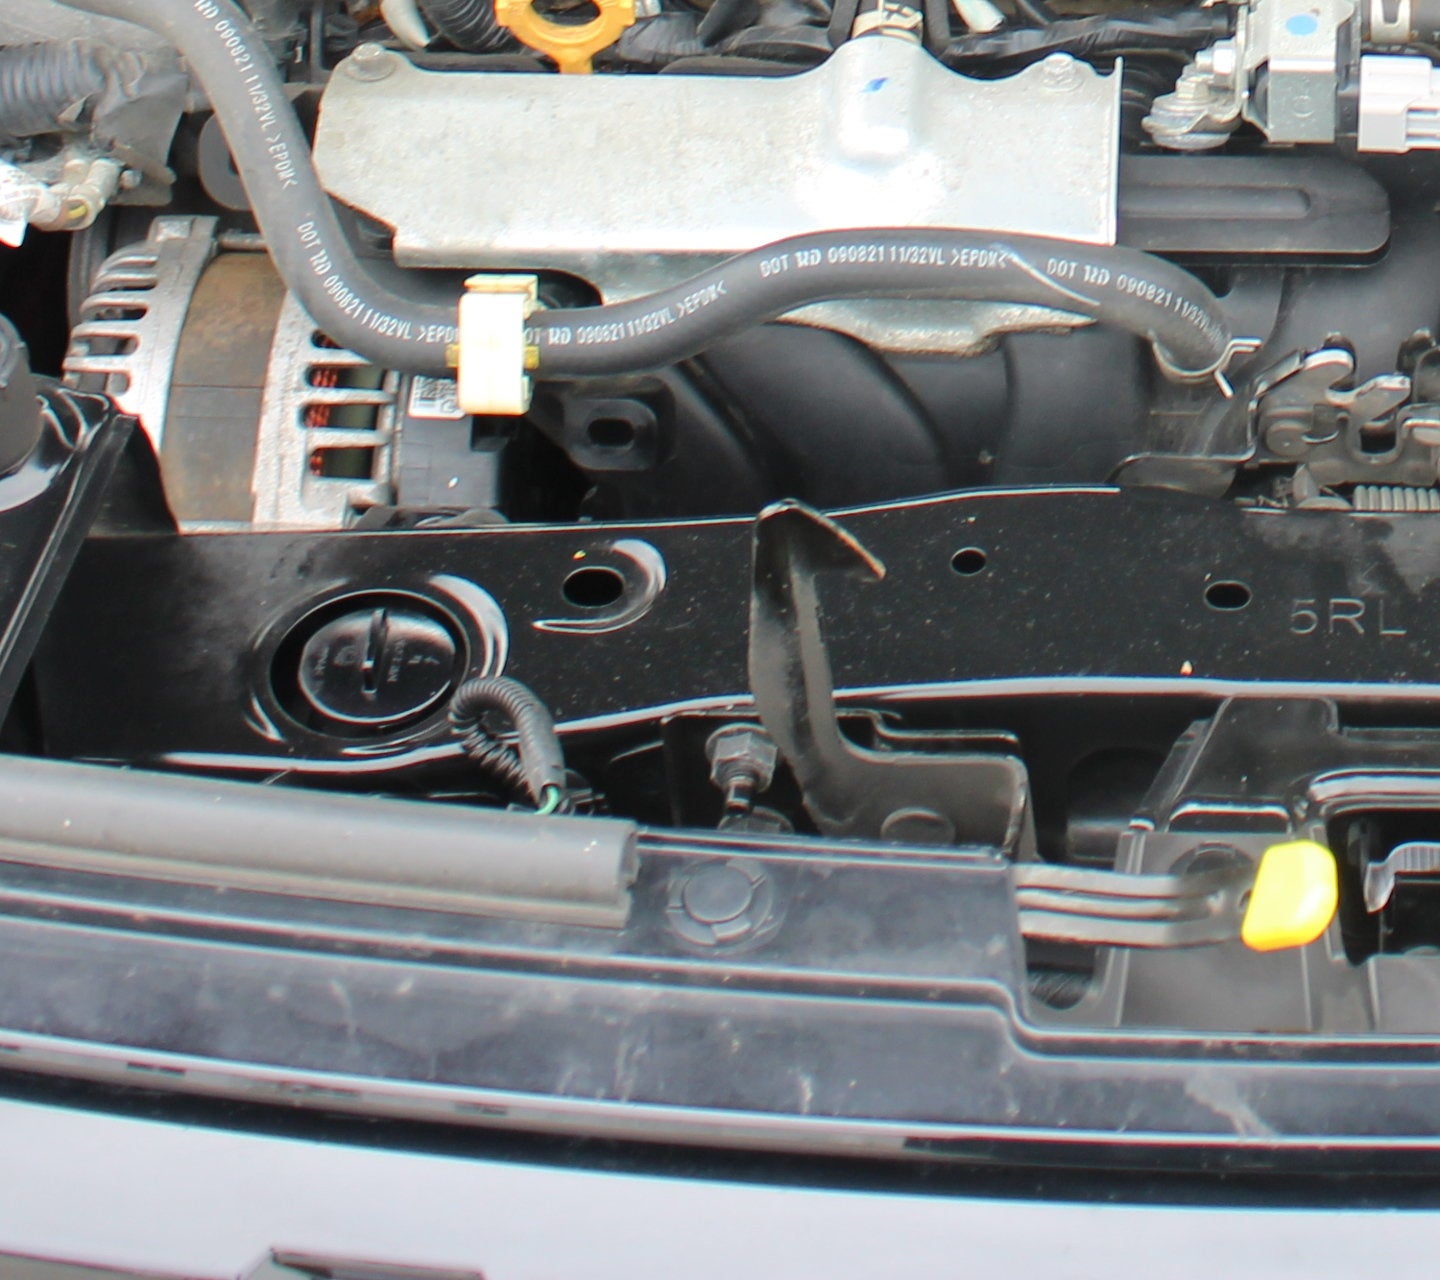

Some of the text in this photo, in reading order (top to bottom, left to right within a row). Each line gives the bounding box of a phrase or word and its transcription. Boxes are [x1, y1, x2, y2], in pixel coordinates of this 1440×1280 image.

[296, 220, 321, 251] DOT
[760, 252, 789, 278] DOT
[827, 243, 886, 266] 090821
[1046, 255, 1078, 278] DOT
[1115, 272, 1173, 308] 090821
[1290, 597, 1408, 635] 5RL
